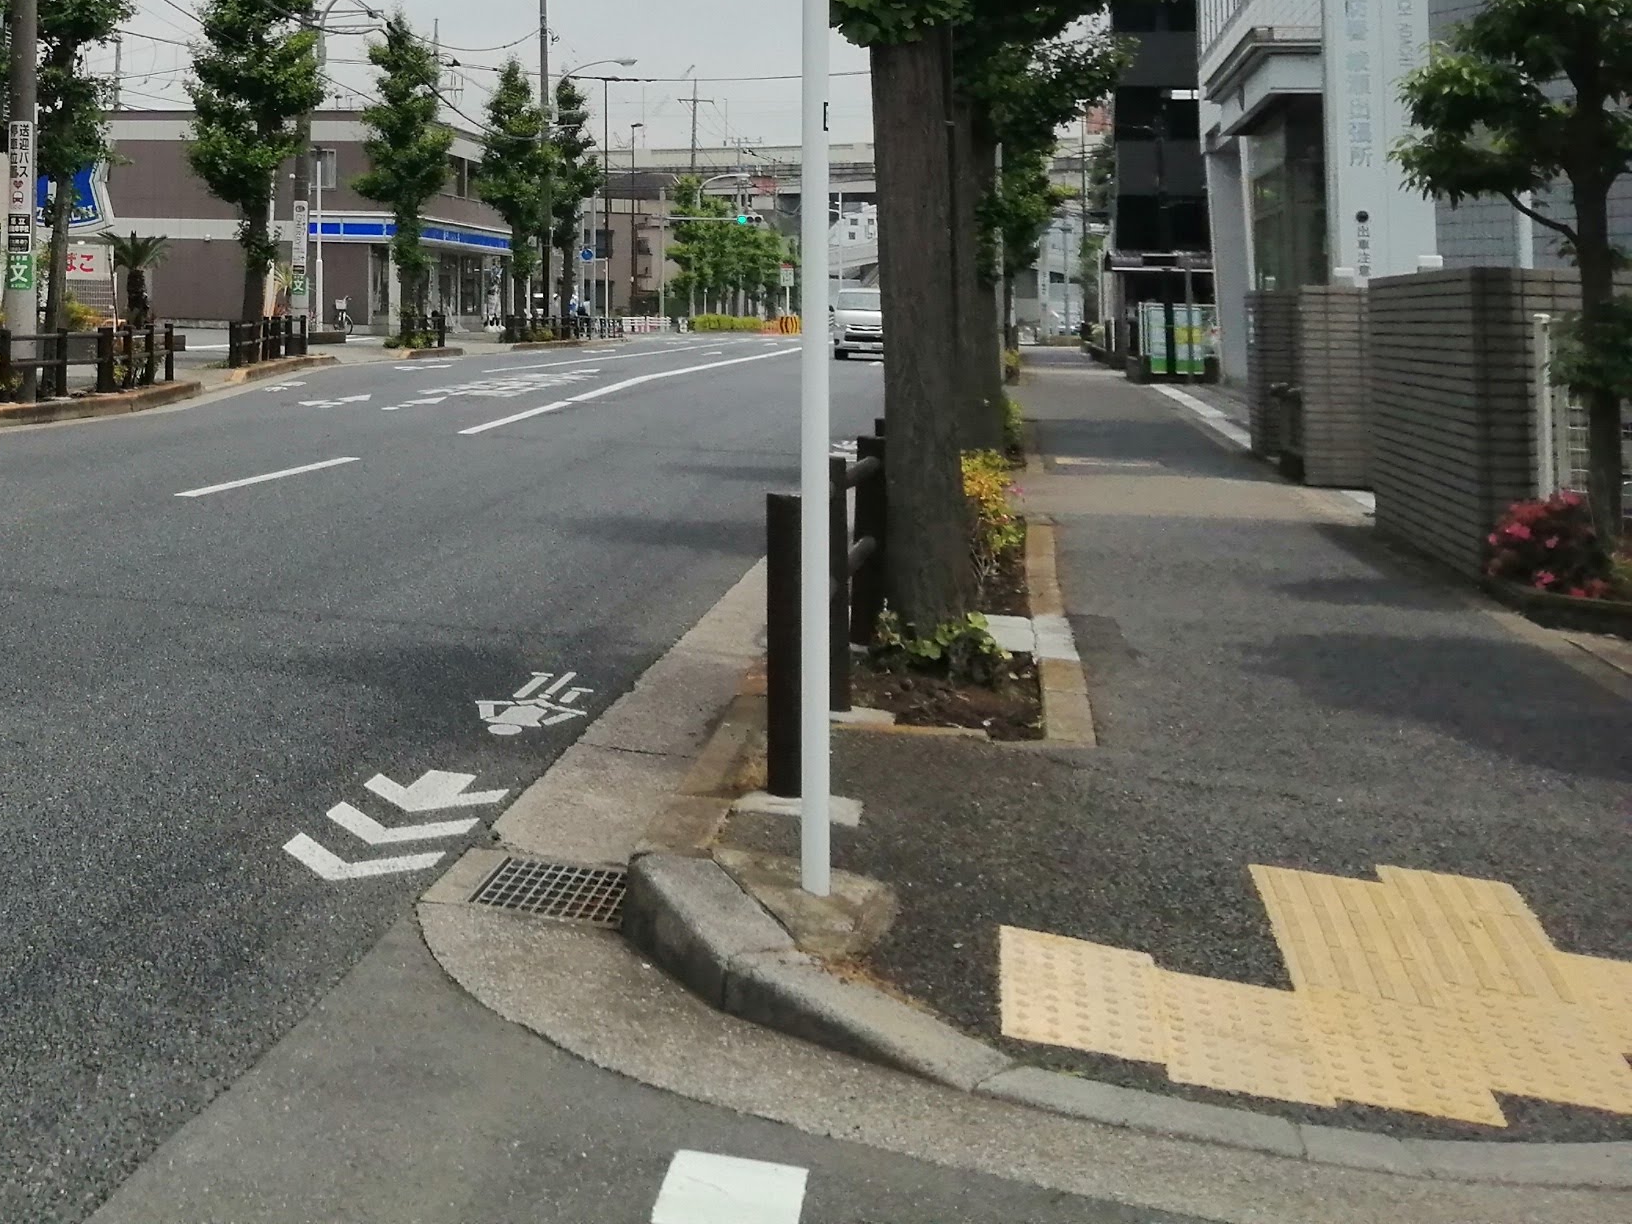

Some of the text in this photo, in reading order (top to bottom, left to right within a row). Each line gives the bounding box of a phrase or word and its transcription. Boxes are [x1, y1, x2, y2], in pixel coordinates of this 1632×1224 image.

[19, 124, 30, 178] 送迎バス
[10, 262, 28, 283] 文
[293, 279, 304, 291] 文
